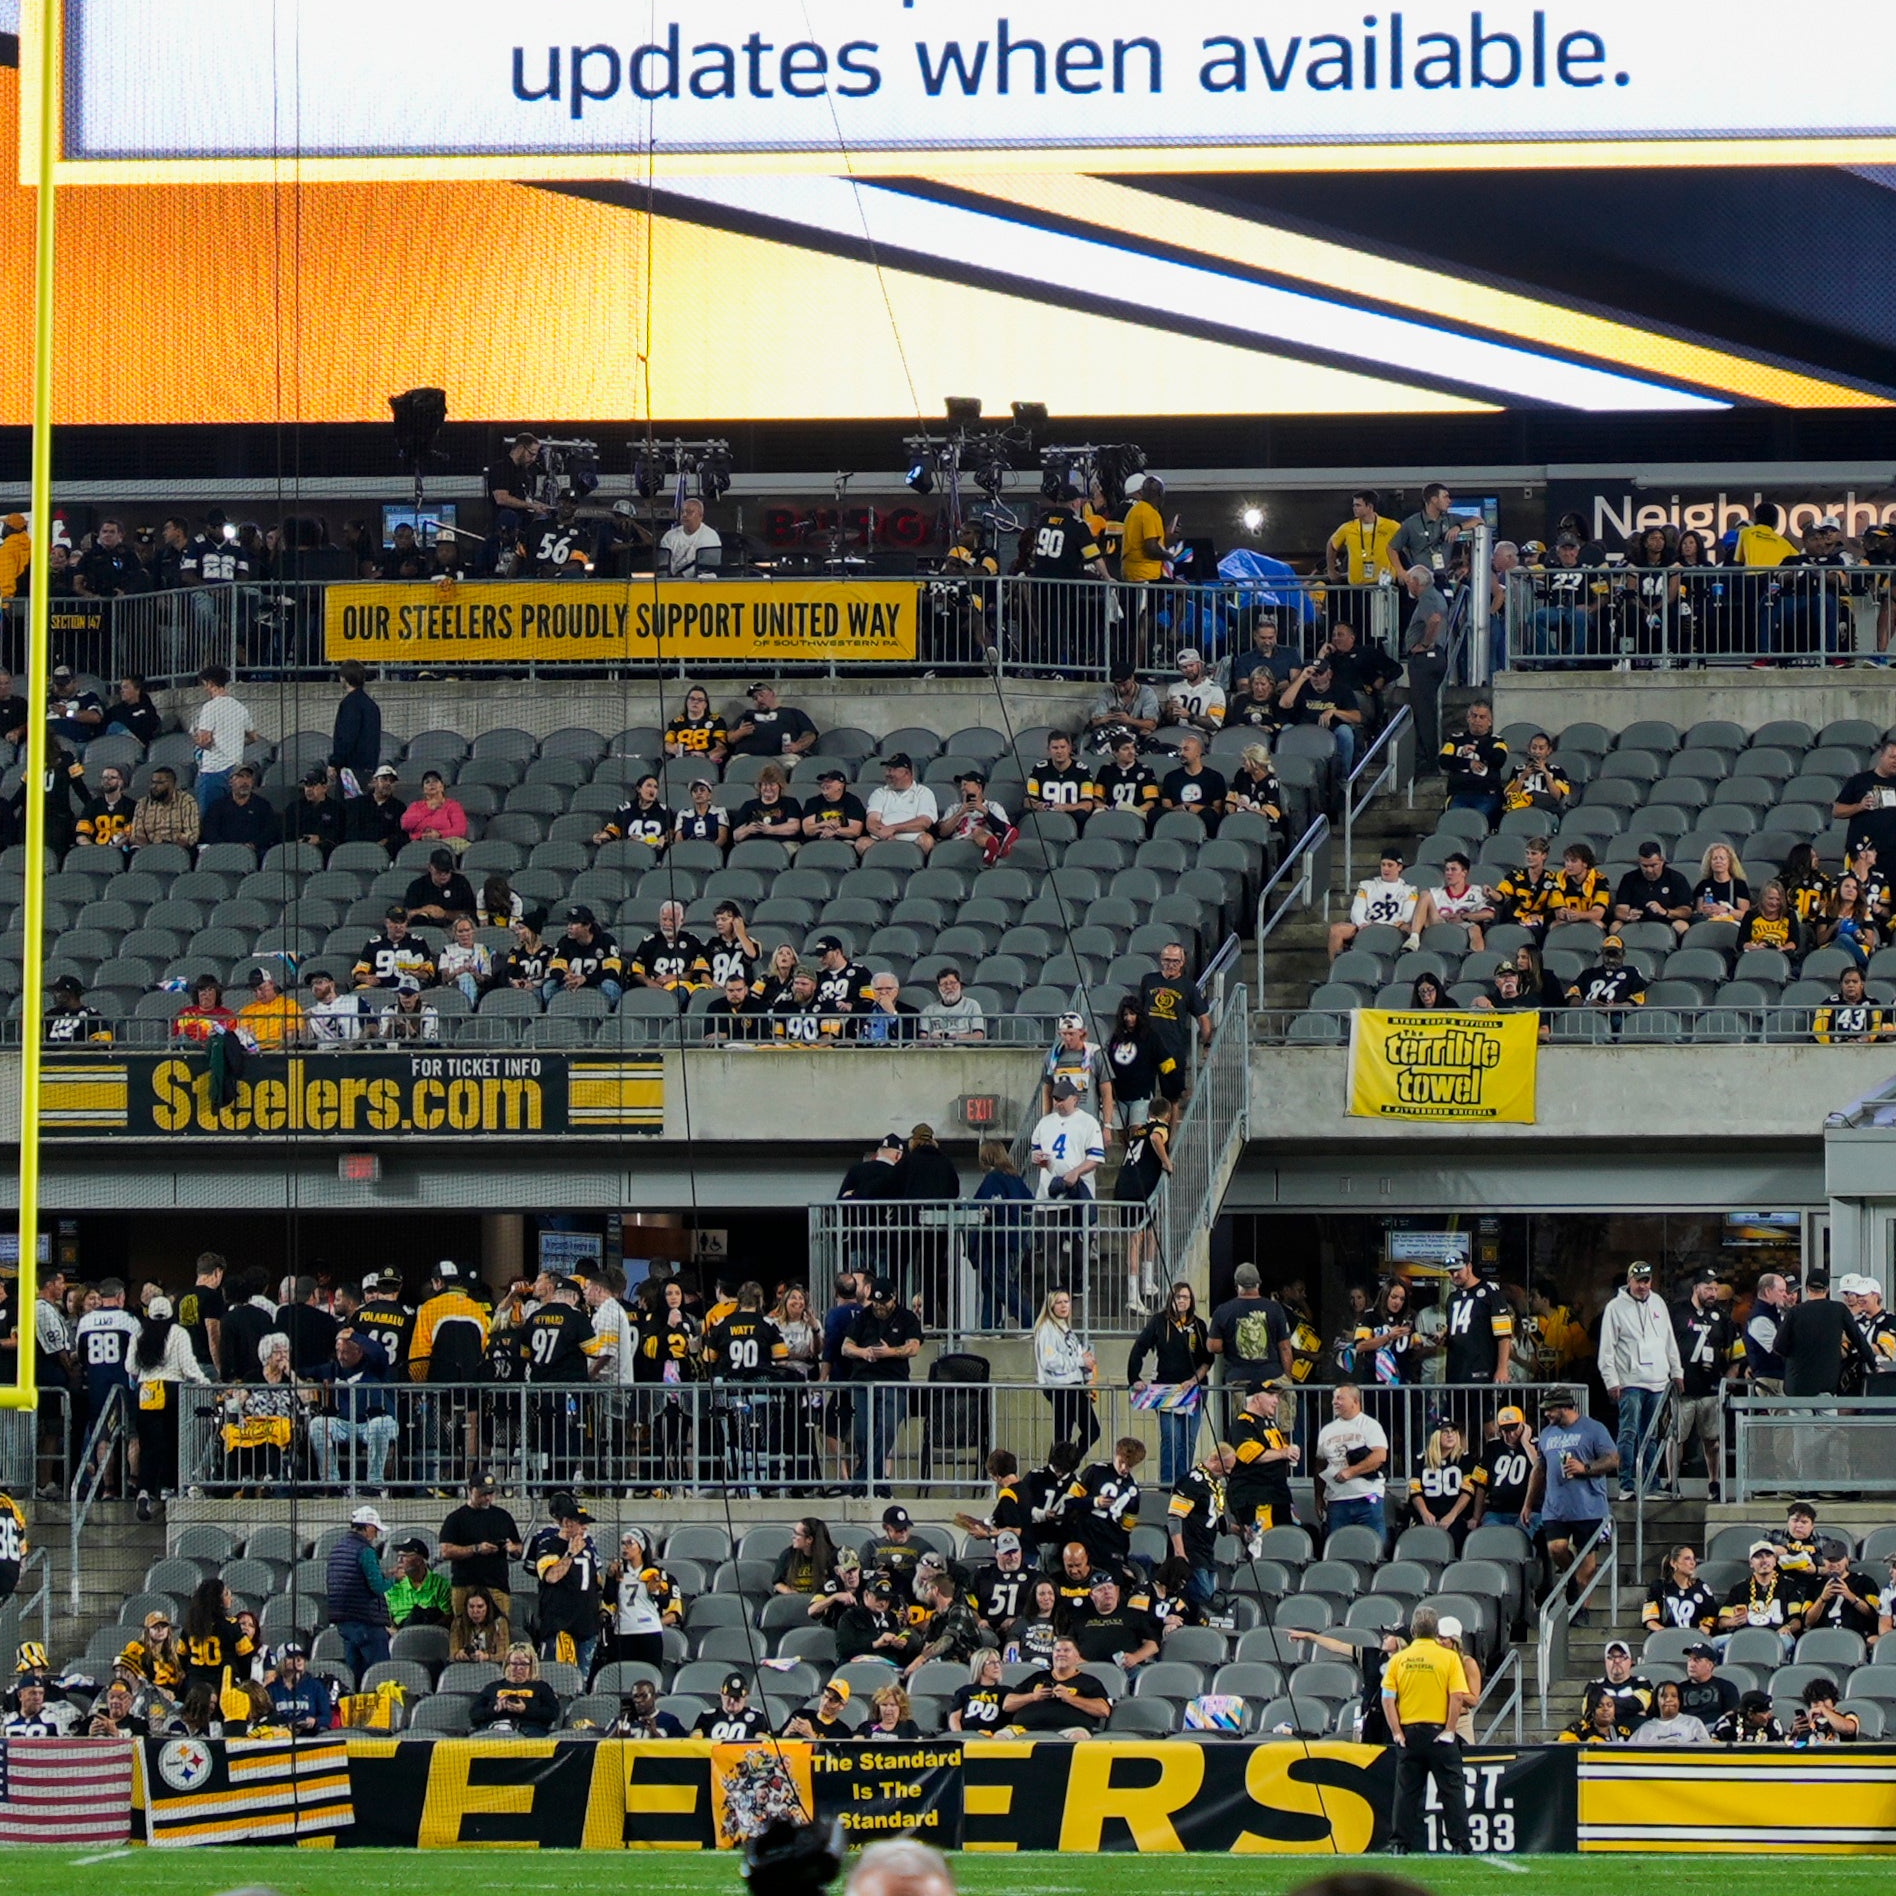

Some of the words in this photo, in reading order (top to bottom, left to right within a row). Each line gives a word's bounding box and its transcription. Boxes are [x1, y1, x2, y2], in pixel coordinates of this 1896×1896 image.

[511, 21, 880, 118] updates
[915, 19, 1161, 97] when
[1198, 10, 1630, 93] available.
[537, 532, 573, 562] 56
[1036, 528, 1065, 557] 90
[50, 614, 85, 629] SECTION
[87, 614, 101, 629] 147
[343, 605, 389, 640] OUR
[398, 604, 512, 640] STEELERS
[521, 604, 627, 639] PROUDLY
[636, 603, 743, 638] SUPPORT
[753, 603, 838, 638] UNITED
[847, 602, 900, 637] WAY
[773, 639, 879, 647] SOUTHWESTERN
[882, 639, 899, 647] PA
[1404, 1029, 1424, 1037] The
[1385, 1029, 1500, 1068] terrible
[412, 1058, 442, 1077] FOR
[447, 1058, 500, 1077] TICKET
[505, 1058, 541, 1076] INFO
[151, 1059, 542, 1131] Steelers.com
[1397, 1066, 1482, 1105] towel
[967, 1098, 993, 1121] EXIT
[1052, 1134, 1066, 1160] 4
[359, 1311, 404, 1327] POLAMALU
[730, 1325, 756, 1336] WATT
[88, 1333, 119, 1364] 88
[531, 1329, 560, 1364] 97
[729, 1339, 759, 1369] 90
[988, 1584, 1019, 1617] 51
[811, 1755, 852, 1772] The
[859, 1749, 962, 1771] Standard
[852, 1783, 873, 1800] Is
[879, 1781, 921, 1799] The
[837, 1809, 938, 1829] Standard
[1423, 1814, 1515, 1851] 133
